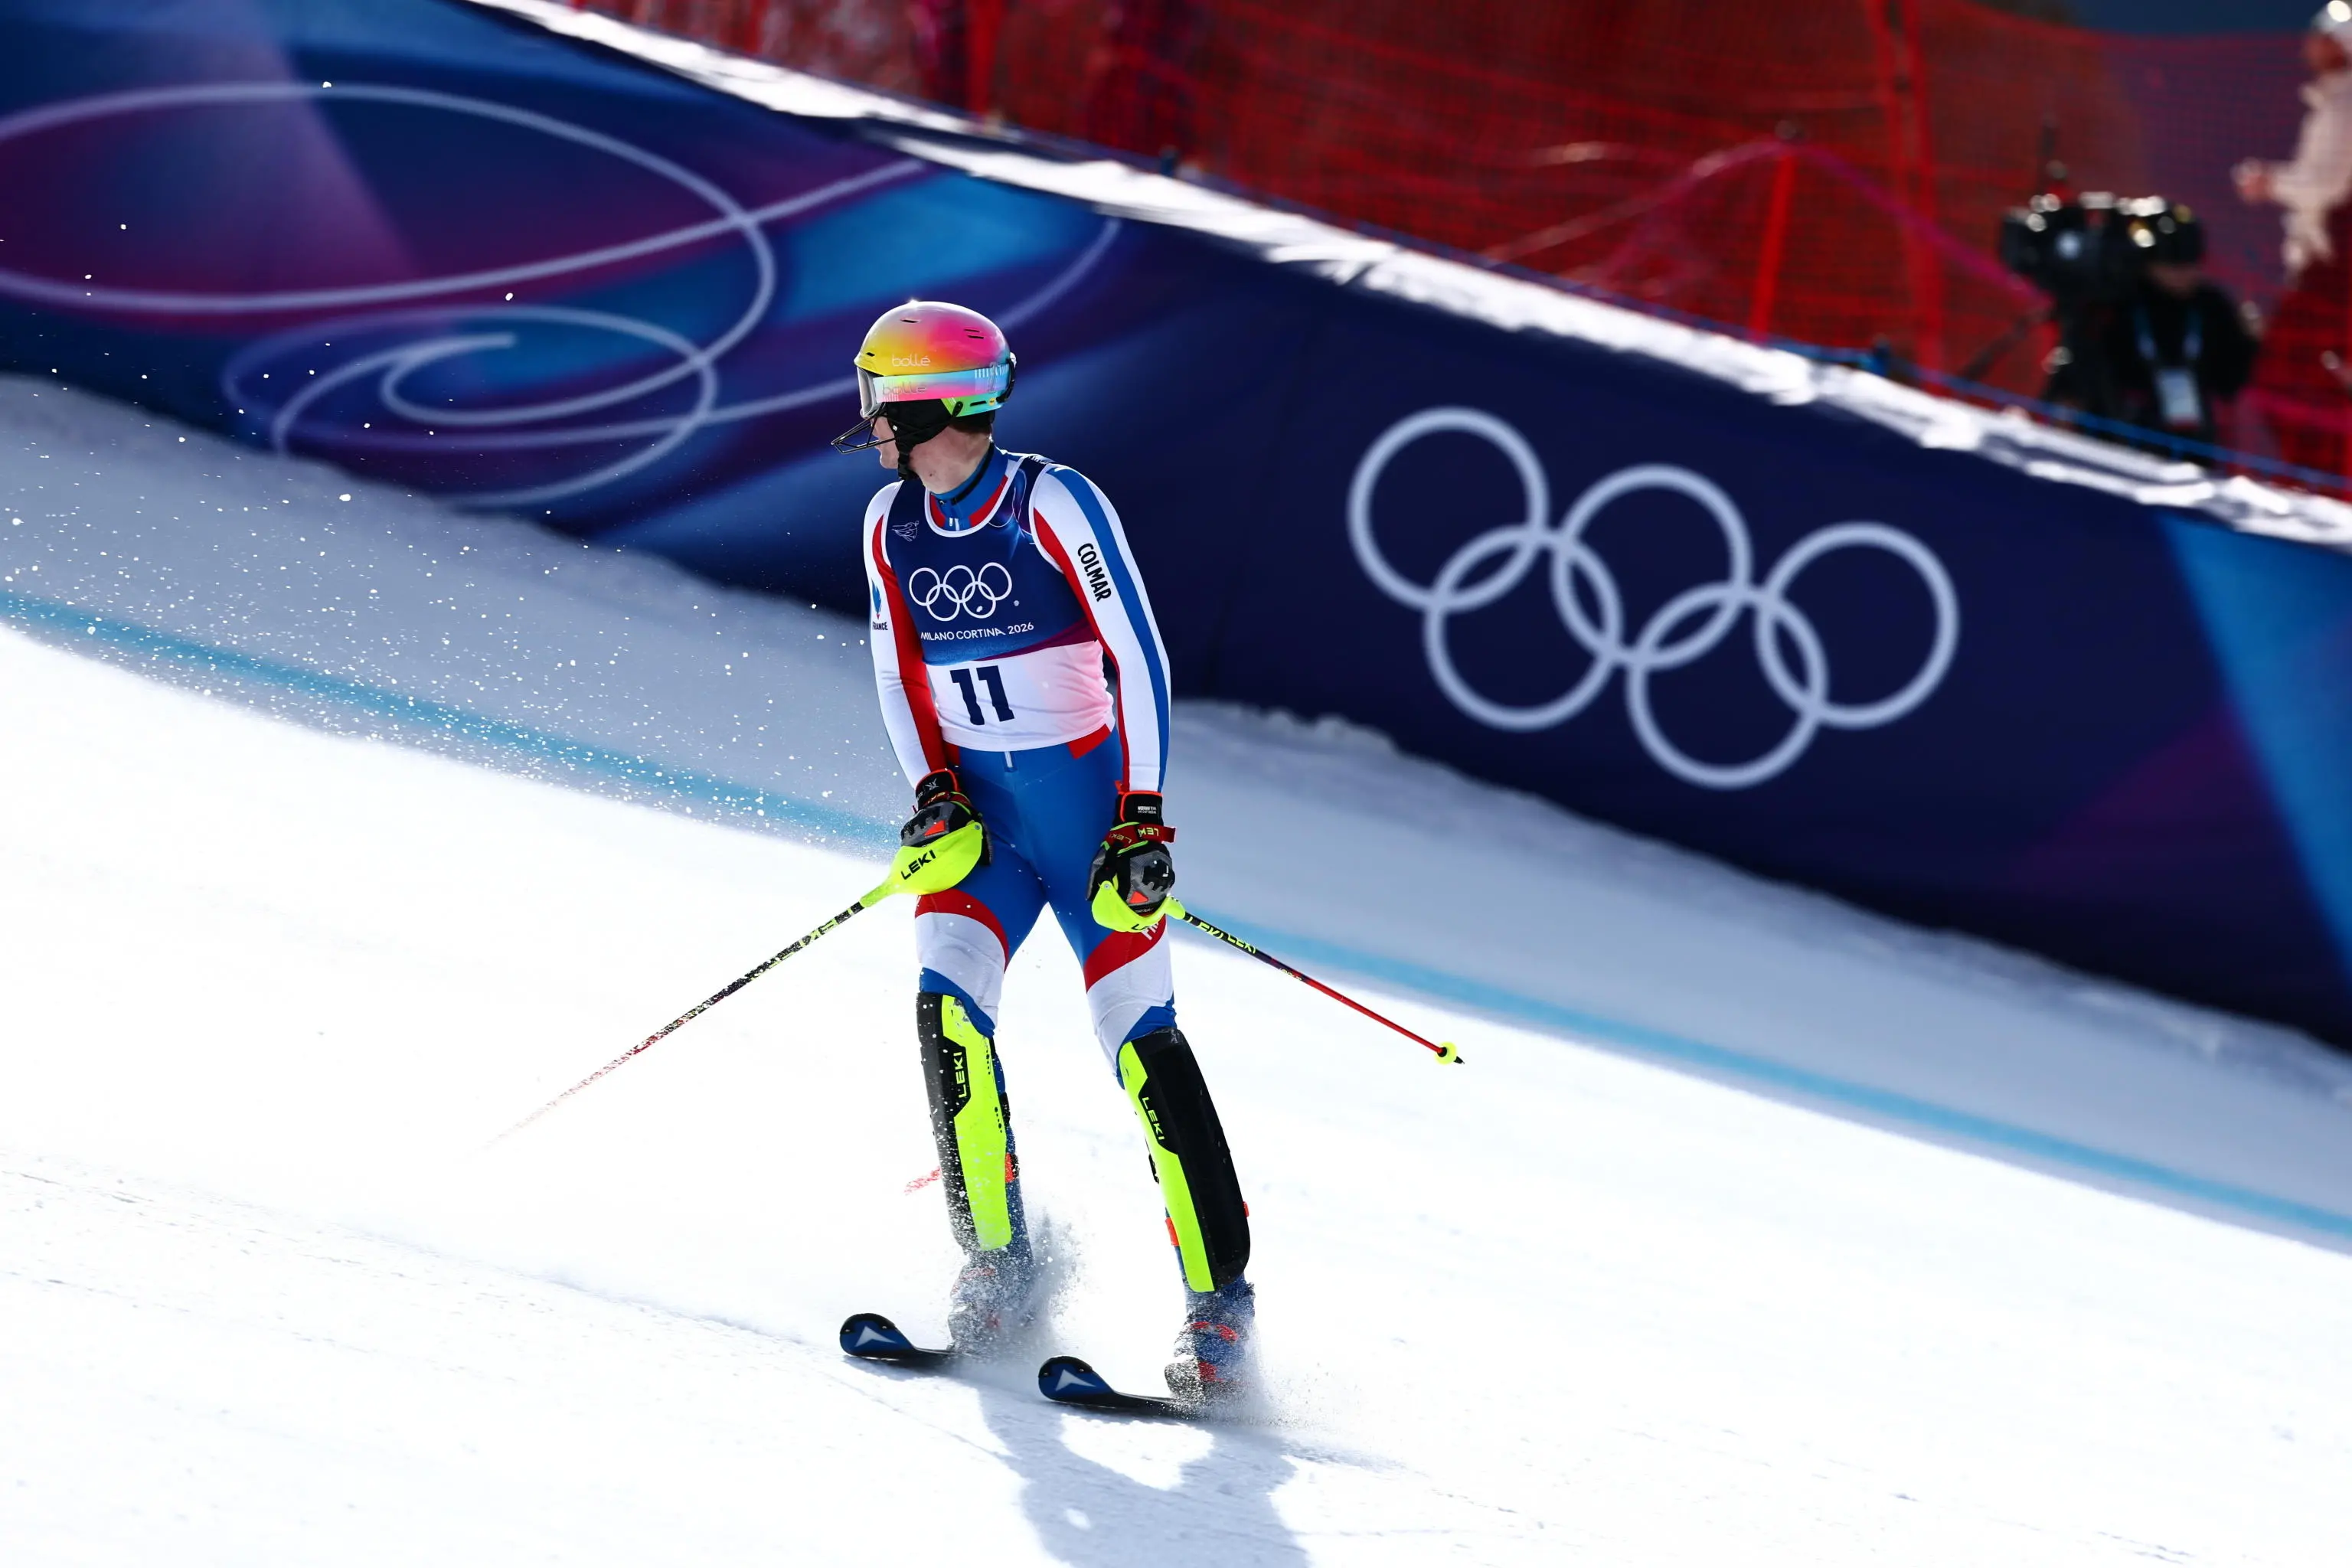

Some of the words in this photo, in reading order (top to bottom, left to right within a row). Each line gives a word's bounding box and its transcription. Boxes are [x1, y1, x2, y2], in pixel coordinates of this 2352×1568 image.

[892, 354, 931, 367] bollé
[1077, 543, 1112, 603] COLMAR
[873, 621, 888, 631] FRANCE
[920, 631, 955, 641] MILANO
[956, 627, 1006, 640] CORTINA
[1007, 622, 1034, 635] 2026
[949, 665, 1014, 726] 11
[900, 849, 936, 880] LEKI
[953, 1051, 967, 1098] LEKI
[1142, 1096, 1165, 1140] LEKI
